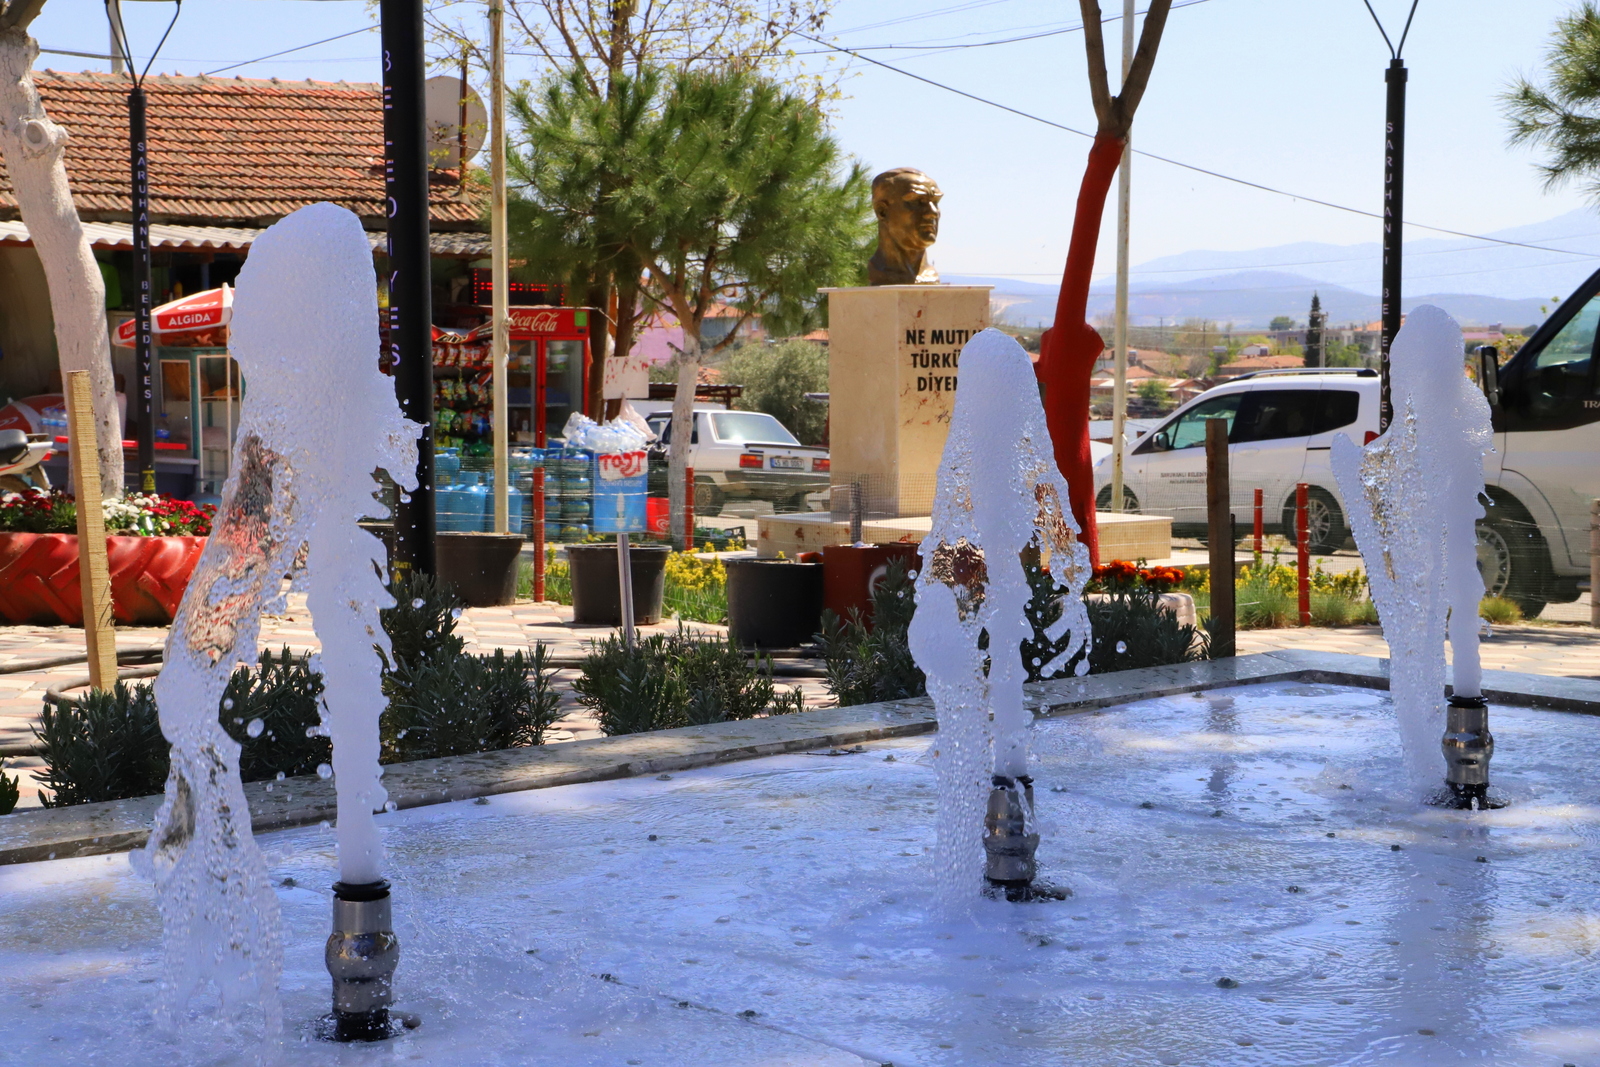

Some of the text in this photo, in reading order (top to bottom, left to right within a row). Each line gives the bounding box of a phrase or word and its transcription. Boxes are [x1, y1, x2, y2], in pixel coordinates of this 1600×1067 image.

[137, 142, 148, 262] SARUHANLI
[1383, 122, 1394, 265] SARUHANLI
[906, 329, 982, 345] NE MUTL
